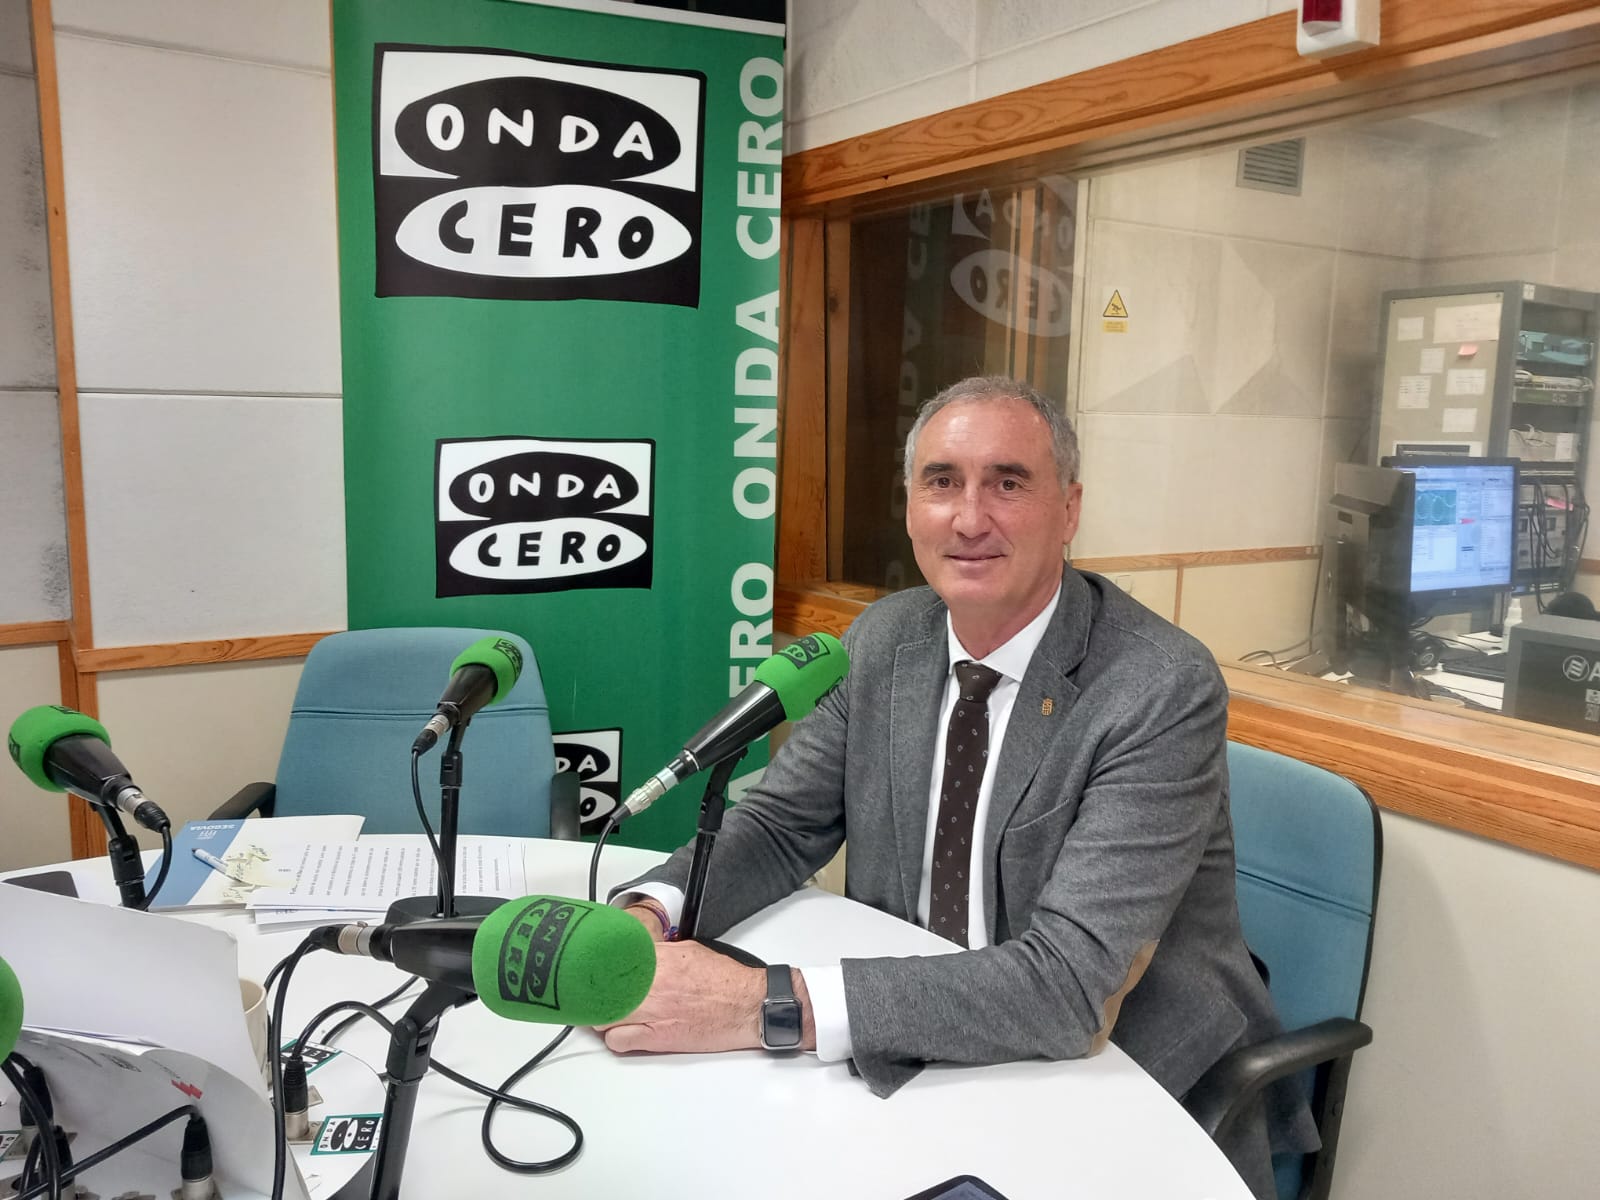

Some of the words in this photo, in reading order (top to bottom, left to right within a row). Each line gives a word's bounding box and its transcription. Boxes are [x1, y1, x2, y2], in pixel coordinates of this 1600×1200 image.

[426, 103, 653, 161] ONDA
[736, 57, 784, 259] CERO
[438, 200, 654, 260] CERO
[732, 290, 779, 519] ONDA
[469, 472, 621, 502] ONDA
[478, 531, 621, 567] CERO
[729, 562, 774, 741] ERO
[555, 754, 598, 773] DA
[507, 908, 545, 986] CERO
[531, 911, 567, 988] ONDA
[320, 1121, 336, 1149] ONDA
[354, 1120, 376, 1150] CERO
